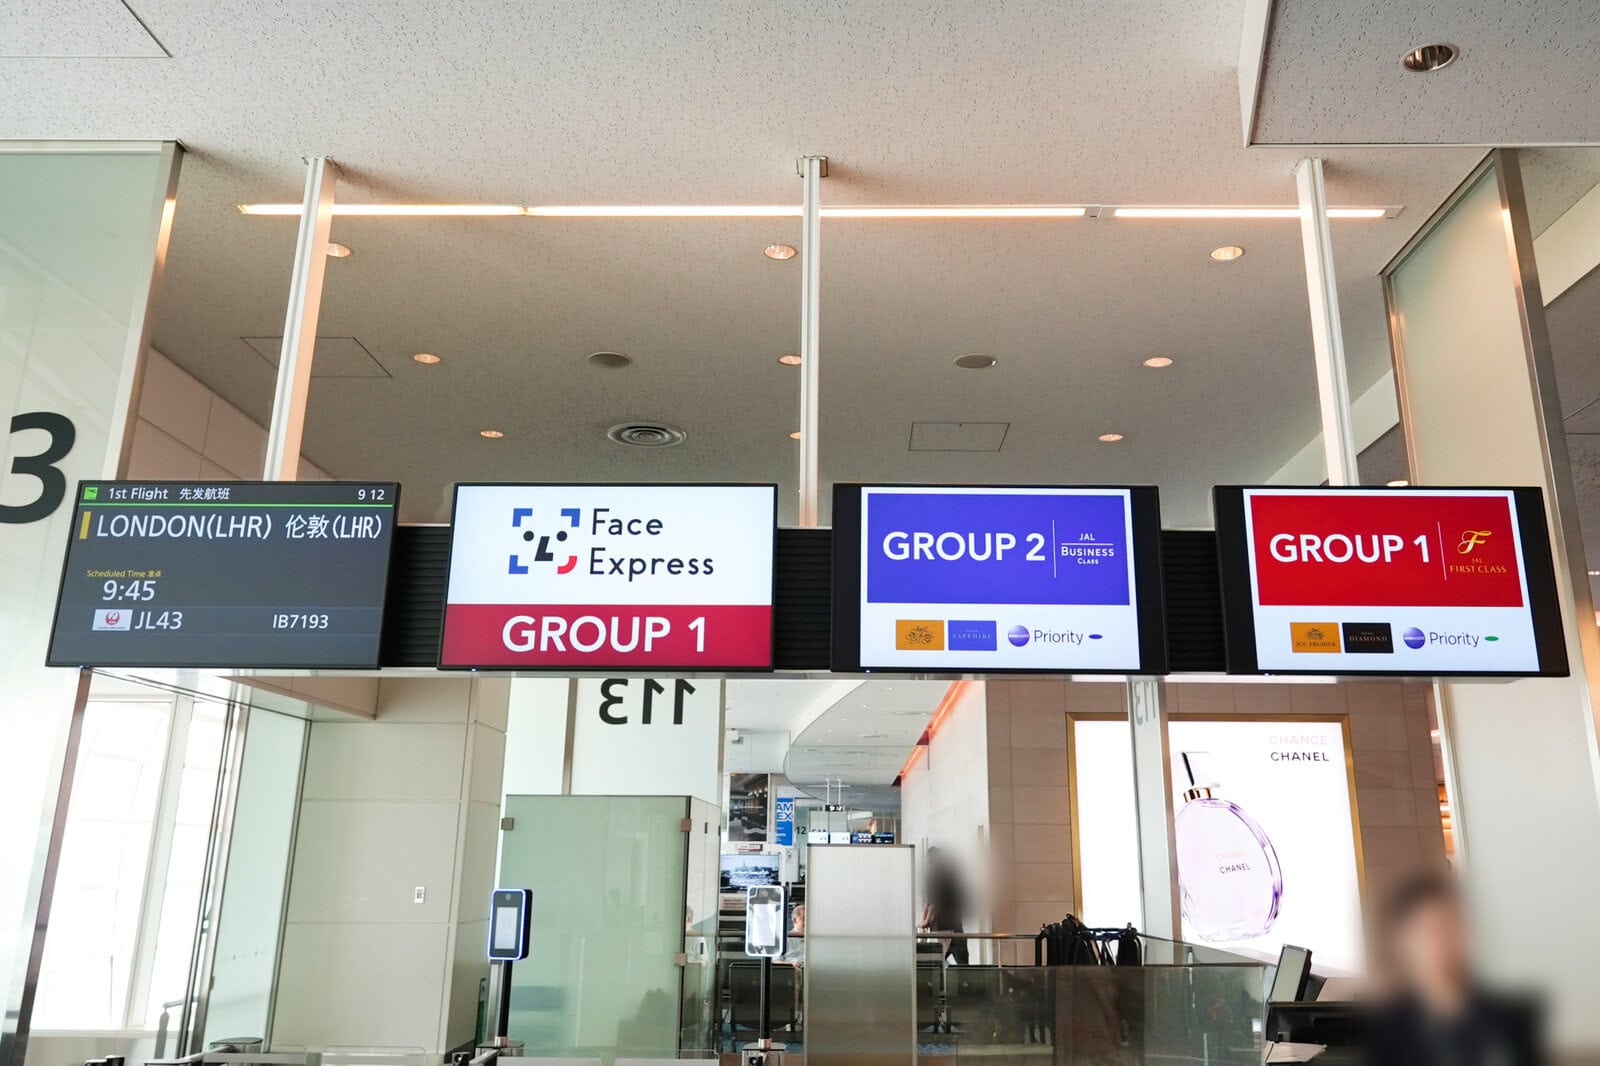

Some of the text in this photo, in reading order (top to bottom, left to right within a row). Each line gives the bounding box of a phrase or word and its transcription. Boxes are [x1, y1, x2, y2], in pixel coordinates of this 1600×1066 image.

[0, 412, 76, 524] 3
[108, 487, 169, 502] 1st Flight
[179, 487, 230, 501] 先发航班
[357, 489, 385, 500] 9 12
[96, 513, 383, 540] LONDON(LHR) 伦敦(LHR)
[592, 508, 664, 536] Face
[1078, 533, 1096, 541] JAL
[882, 531, 1046, 561] GROUP 2
[1269, 533, 1430, 563] GROUP 1
[589, 547, 715, 582] Express
[1449, 565, 1507, 574] FIRST CLASS
[86, 569, 126, 578] Scheduled
[127, 569, 146, 578] Time
[102, 579, 156, 601] 9:45
[134, 611, 183, 630] JL43
[272, 614, 329, 629] IB7193
[502, 615, 706, 653] GROUP 1
[1033, 629, 1084, 646] Priority
[1429, 631, 1480, 648] Priority
[1268, 735, 1329, 745] CHANCE
[1270, 751, 1330, 762] CHANEL
[1219, 863, 1251, 874] CHANEL
